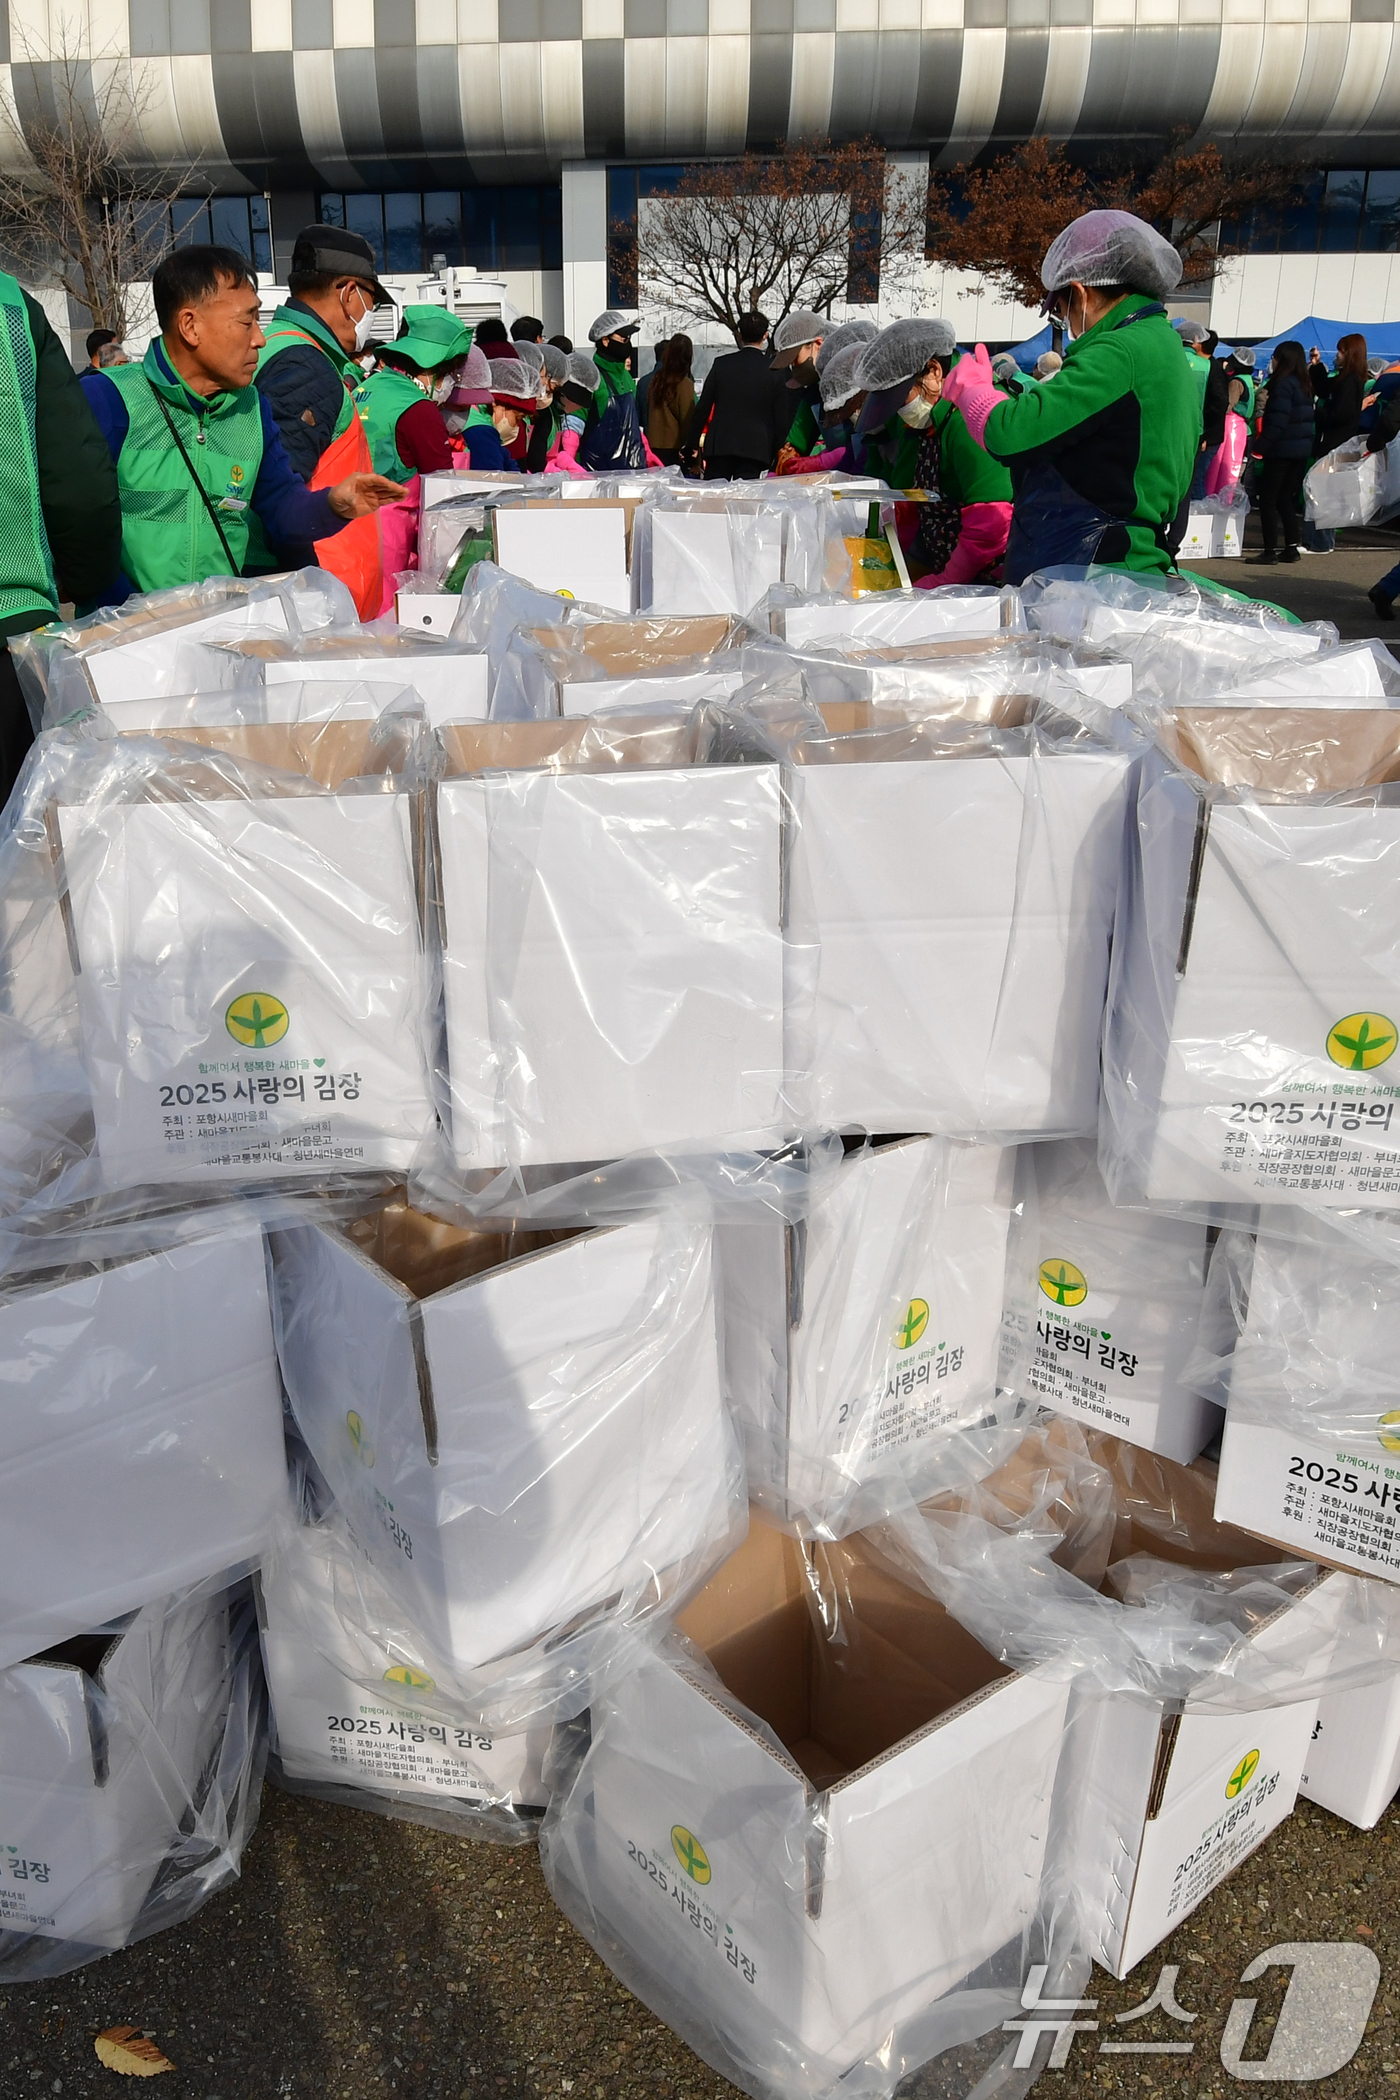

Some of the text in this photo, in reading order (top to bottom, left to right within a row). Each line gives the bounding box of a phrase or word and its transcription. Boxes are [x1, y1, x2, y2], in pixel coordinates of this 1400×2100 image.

[198, 1059, 310, 1075] 함께여서 행복한 새마을
[159, 1072, 363, 1107] 2025 사랑의 김장
[1332, 1083, 1367, 1096] 행복한
[162, 1110, 268, 1126] 주최 포항시새마을회
[1229, 1101, 1394, 1131] 2025 사랑의
[164, 1129, 185, 1141] 주관
[281, 1135, 333, 1148] 새마을문고
[1224, 1131, 1248, 1144] 주최
[1259, 1147, 1362, 1163] 새마을지도자협의회
[1258, 1162, 1336, 1177] 직장공장협의회
[1046, 1310, 1070, 1326] 행복한
[1073, 1321, 1098, 1338] 새마을
[1036, 1320, 1091, 1360] 사랑의
[1098, 1343, 1139, 1377] 김장
[886, 1361, 930, 1399] 사랑의
[936, 1346, 964, 1380] 김장
[1081, 1376, 1106, 1394] 부녀회
[1064, 1381, 1106, 1404] 새마을문고
[1072, 1396, 1131, 1428] 청년새마을연대
[1288, 1456, 1359, 1494] 2025
[1284, 1494, 1306, 1510] 주관
[1285, 1482, 1396, 1528] 주최 포항시새마을회
[389, 1517, 413, 1560] 김장
[1282, 1506, 1392, 1553] 후원 직장공장협의회
[327, 1716, 382, 1734] 2025
[387, 1721, 447, 1745] 사랑의
[357, 1750, 433, 1765] 새마을지도자협의회
[1174, 1836, 1212, 1883] 2025
[1212, 1796, 1253, 1844] 사랑의
[1255, 1770, 1280, 1808] 김장
[8, 1858, 50, 1883] 김장
[628, 1840, 757, 1984] 2025 사랑의 김장
